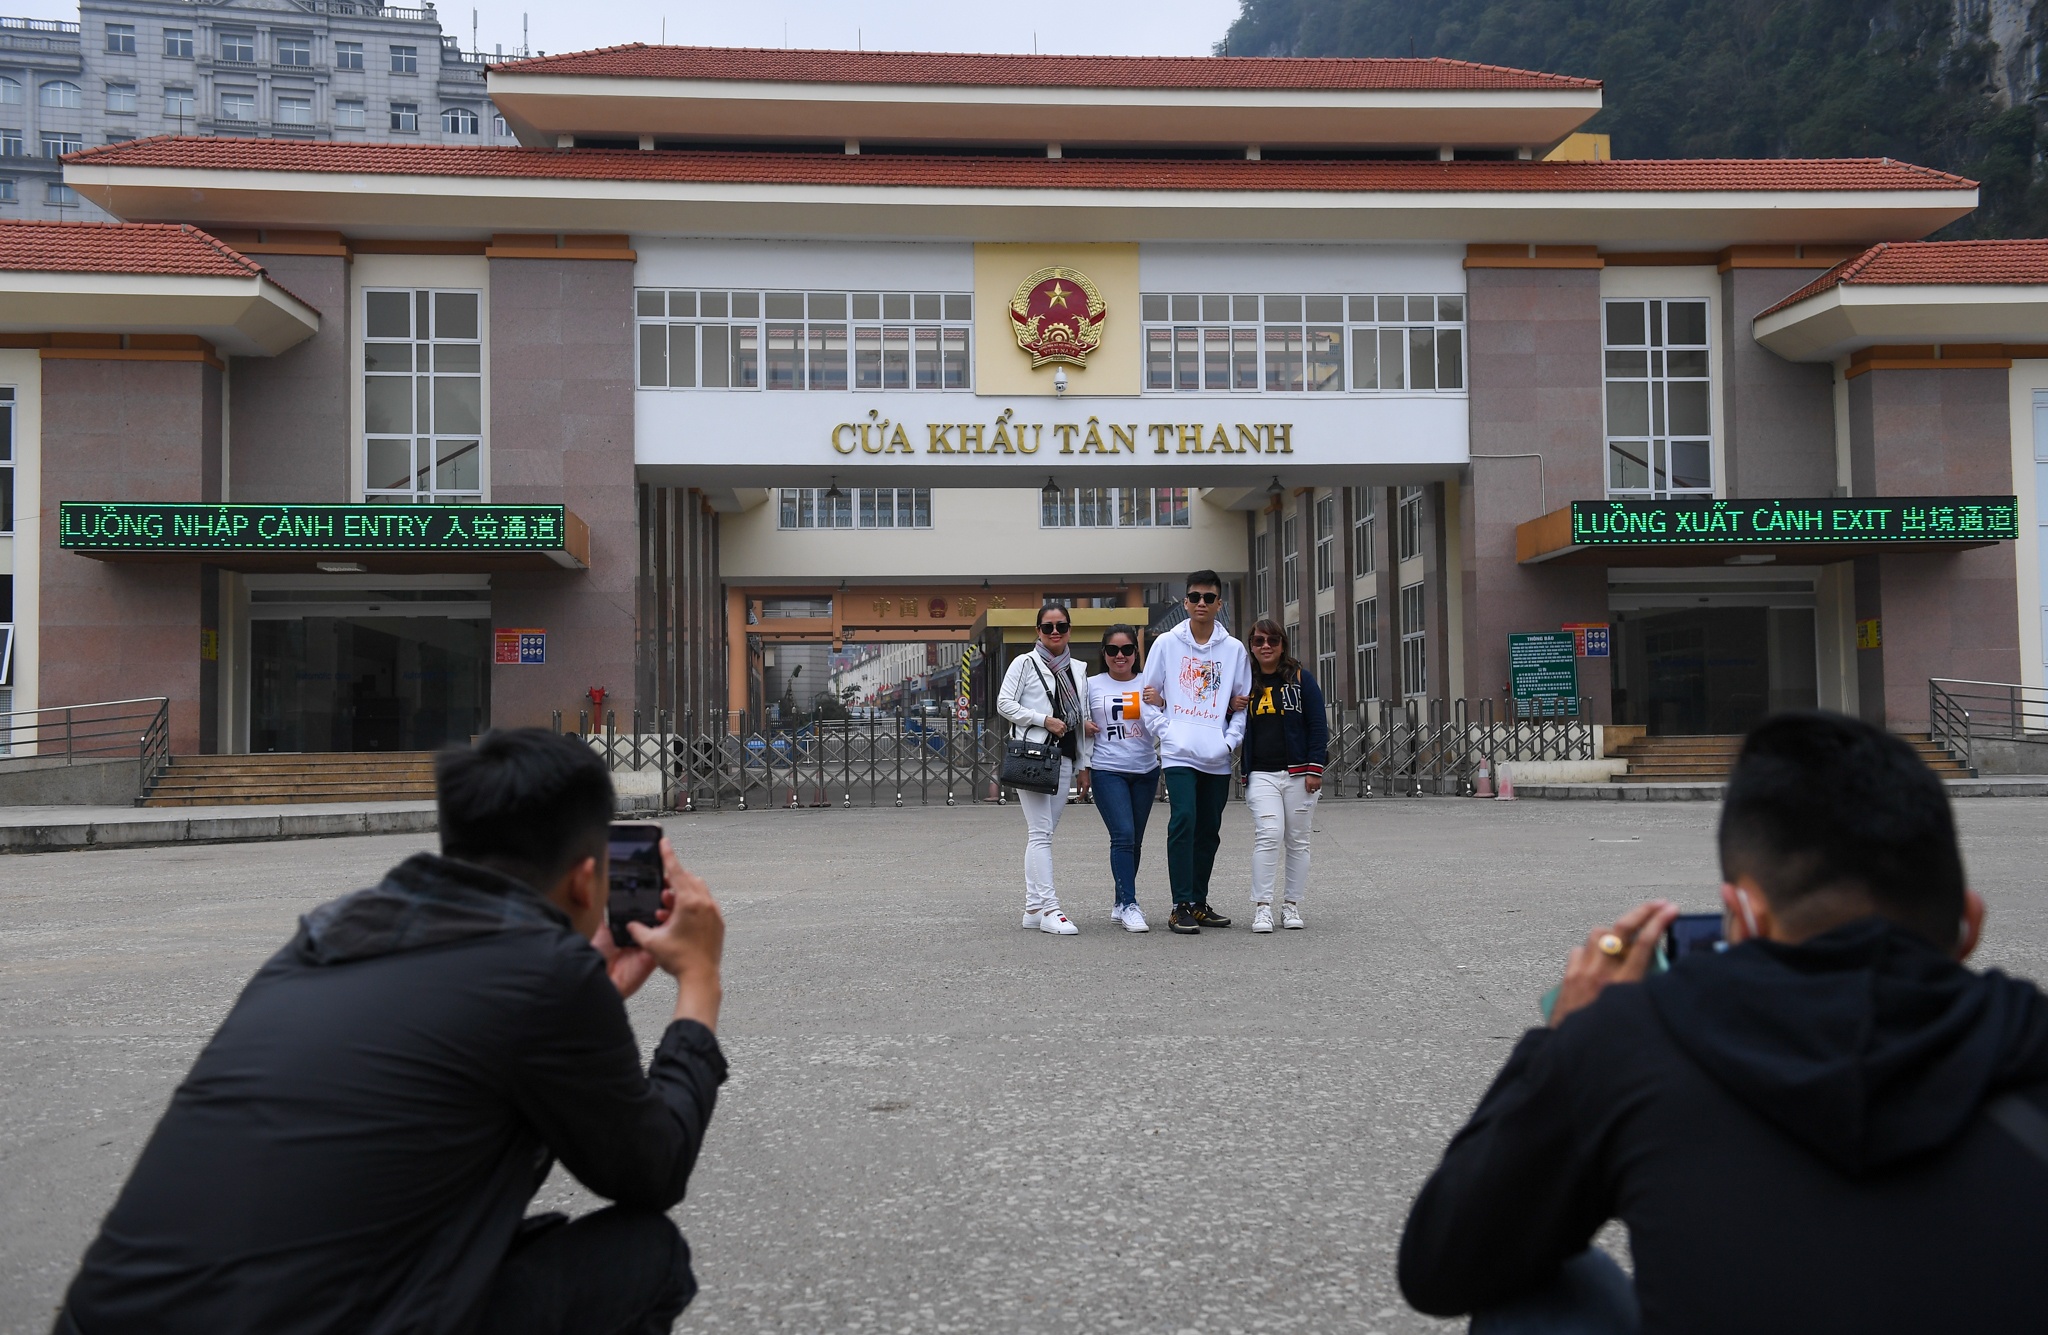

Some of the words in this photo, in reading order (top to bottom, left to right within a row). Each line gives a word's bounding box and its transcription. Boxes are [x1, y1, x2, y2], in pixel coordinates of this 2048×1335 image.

[831, 409, 914, 454] CỬA
[926, 408, 1043, 454] KHẨU
[1053, 415, 1138, 453] TÂN
[1148, 423, 1294, 453] THANH
[174, 507, 249, 541] NHẬP
[258, 508, 333, 539] CẢNH
[344, 515, 432, 537] ENTRY
[443, 513, 557, 539] 入境通道
[1675, 502, 1744, 532] XUẤT
[1752, 501, 1822, 531] CẢNH
[1833, 509, 1892, 530] EXIT
[1902, 506, 2013, 531] 出境通道
[872, 596, 919, 618] 中国
[960, 697, 966, 707] 5
[1173, 704, 1220, 720] Predator
[1106, 722, 1144, 742] FILA
